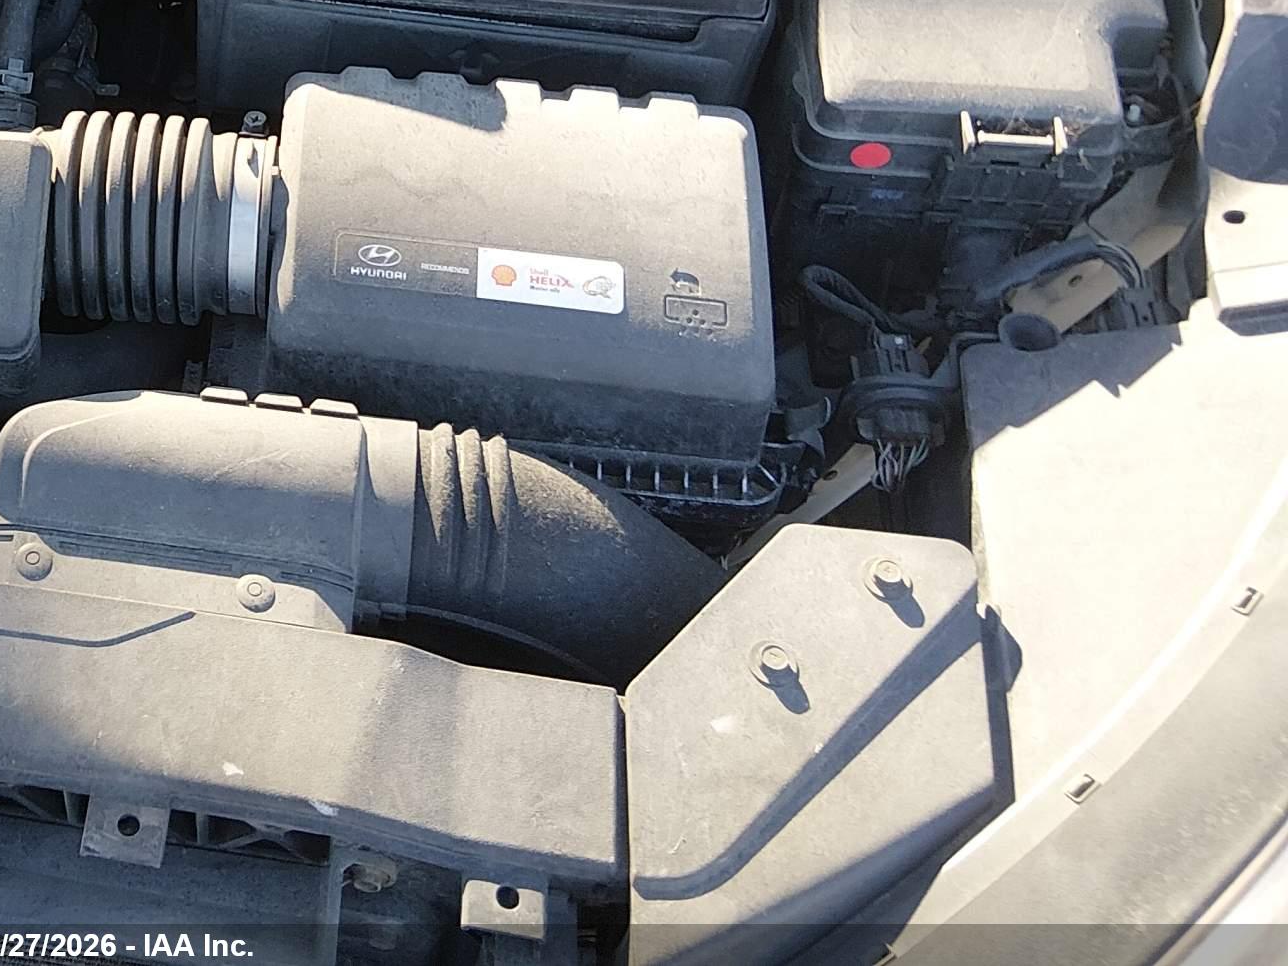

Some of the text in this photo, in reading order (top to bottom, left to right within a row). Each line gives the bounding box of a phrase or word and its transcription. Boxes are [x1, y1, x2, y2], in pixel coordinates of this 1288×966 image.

[350, 266, 407, 280] HYUNDAI
[529, 267, 549, 276] Shell
[529, 274, 574, 288] HELIX
